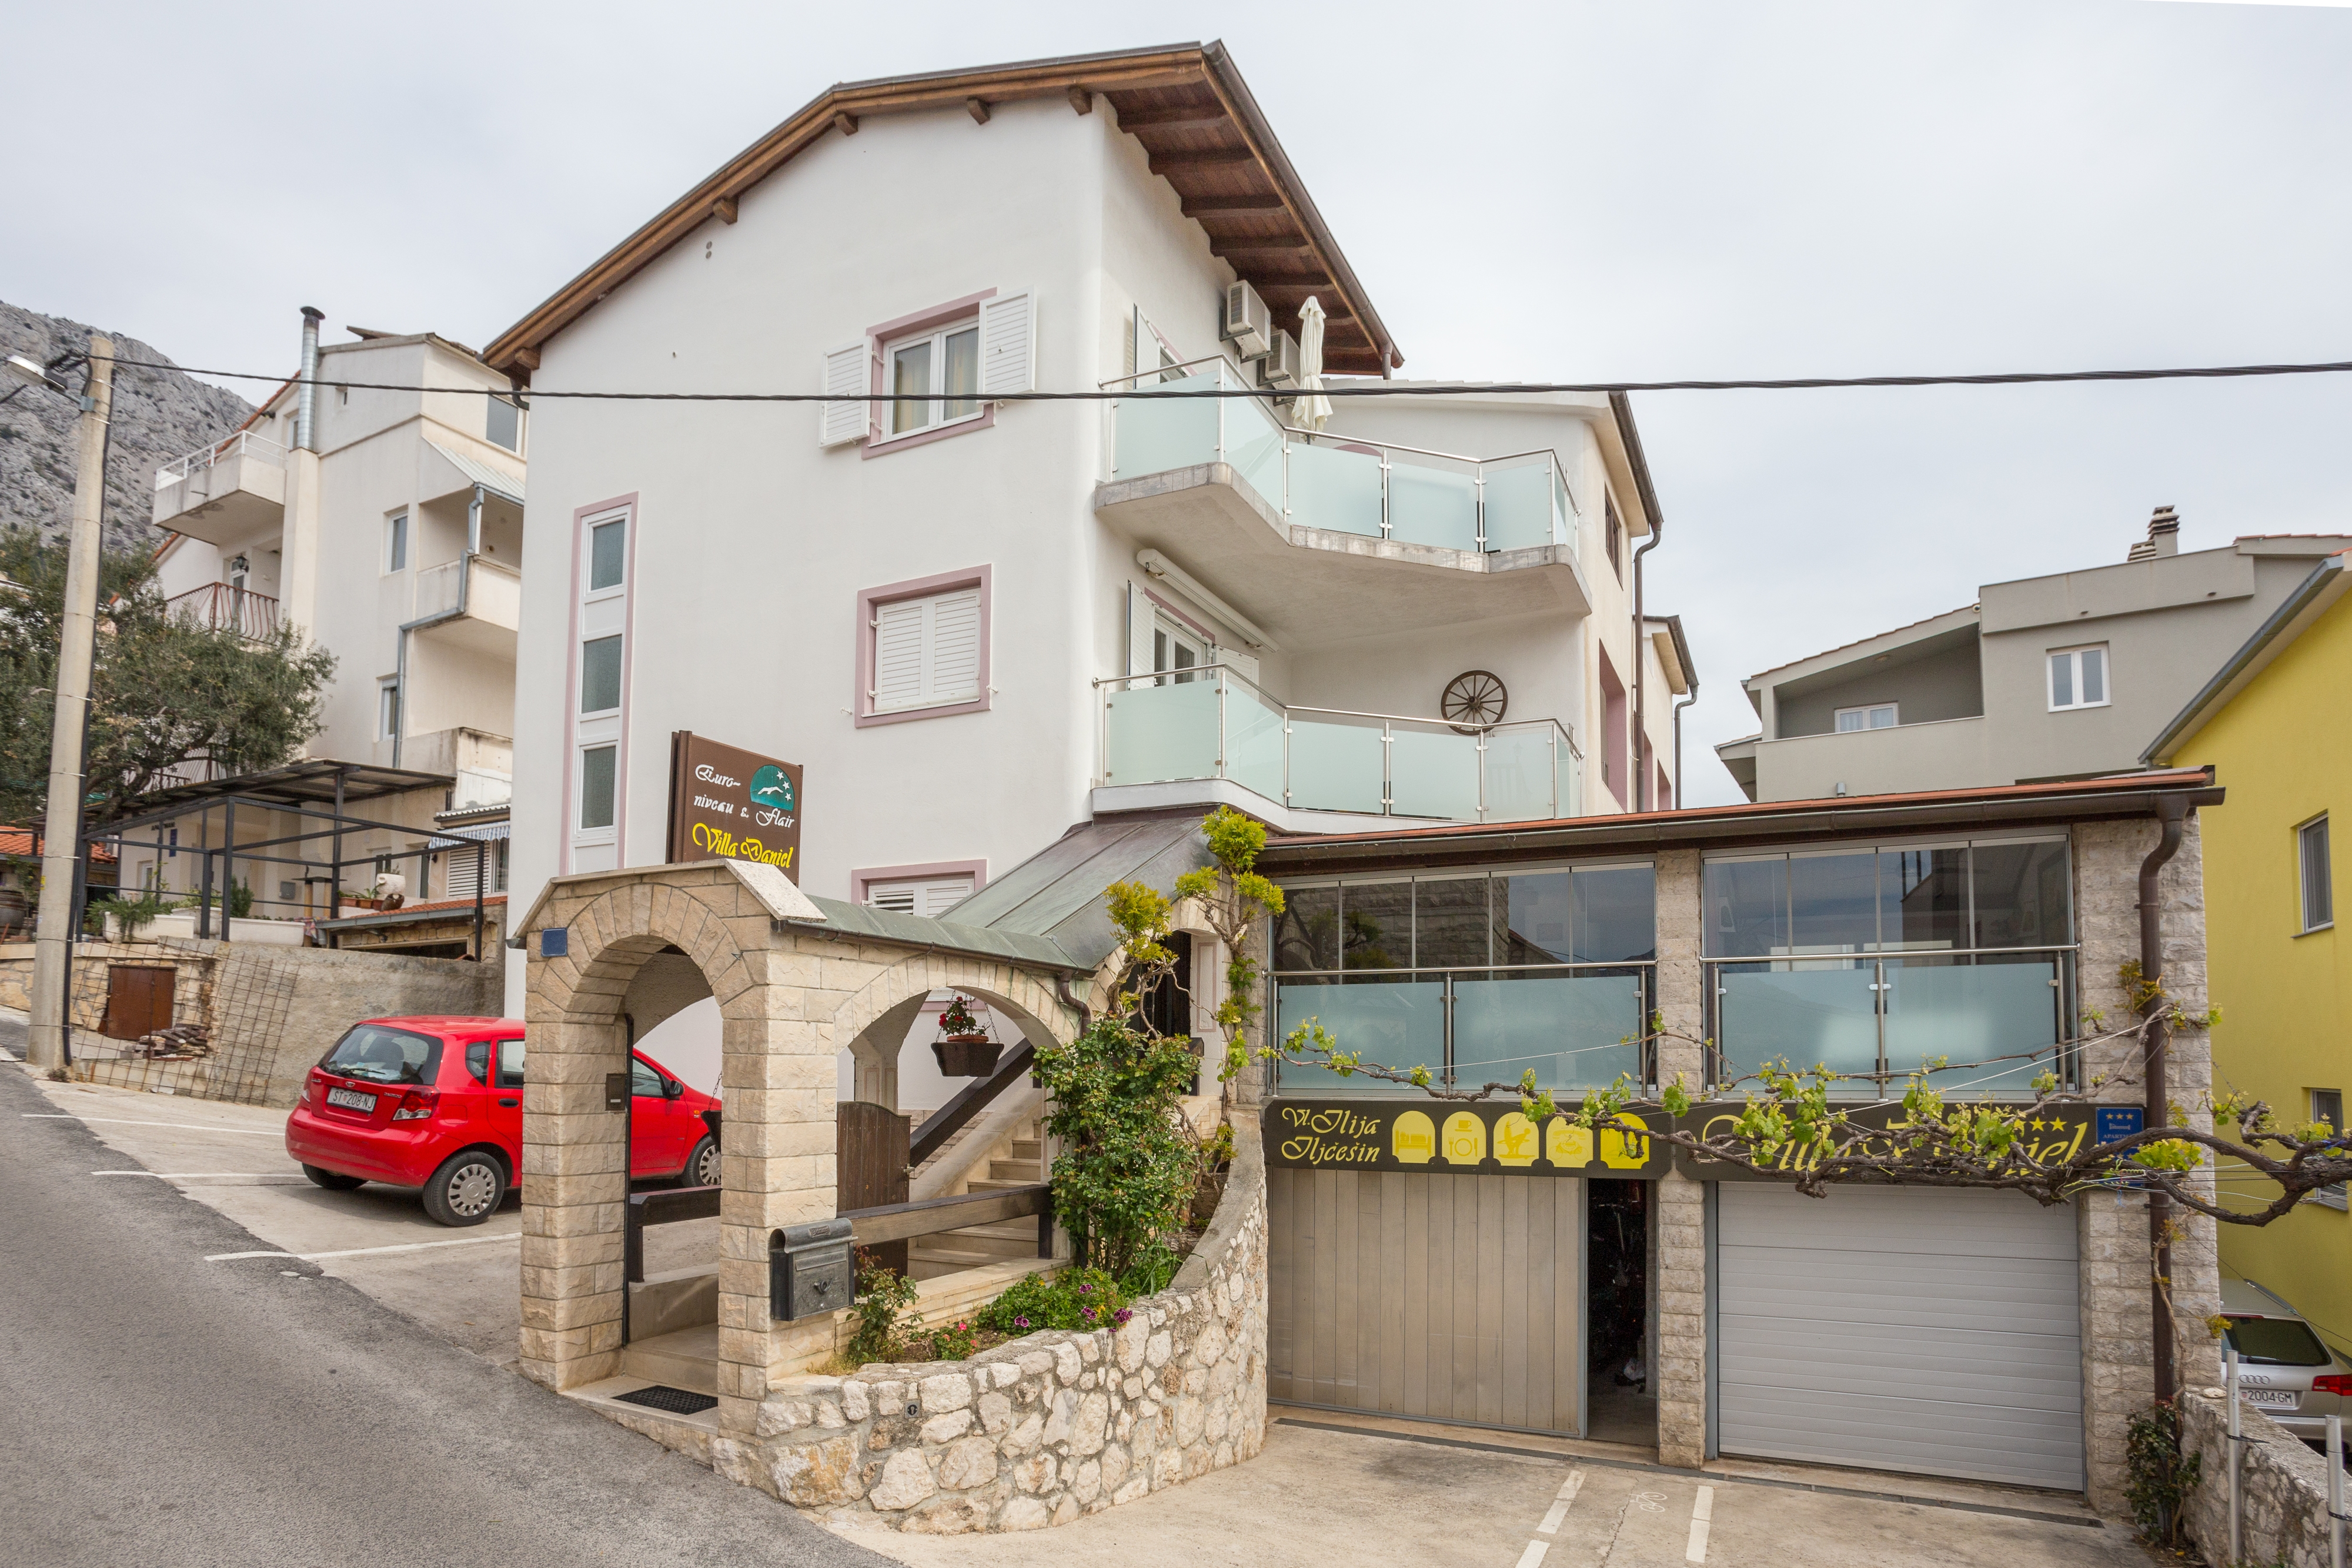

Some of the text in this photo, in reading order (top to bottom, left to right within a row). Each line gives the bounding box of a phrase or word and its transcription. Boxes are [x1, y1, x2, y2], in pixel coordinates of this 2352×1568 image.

[695, 764, 741, 787] Euro-
[693, 794, 795, 828] niveau & Flair
[692, 823, 794, 868] Villa Daniel
[333, 1091, 343, 1102] ST
[346, 1094, 375, 1109] 208-NJ
[1311, 1109, 1381, 1139] Ilija
[1281, 1136, 1381, 1165] Iljčešin
[2247, 1390, 2293, 1403] 2004-GM
